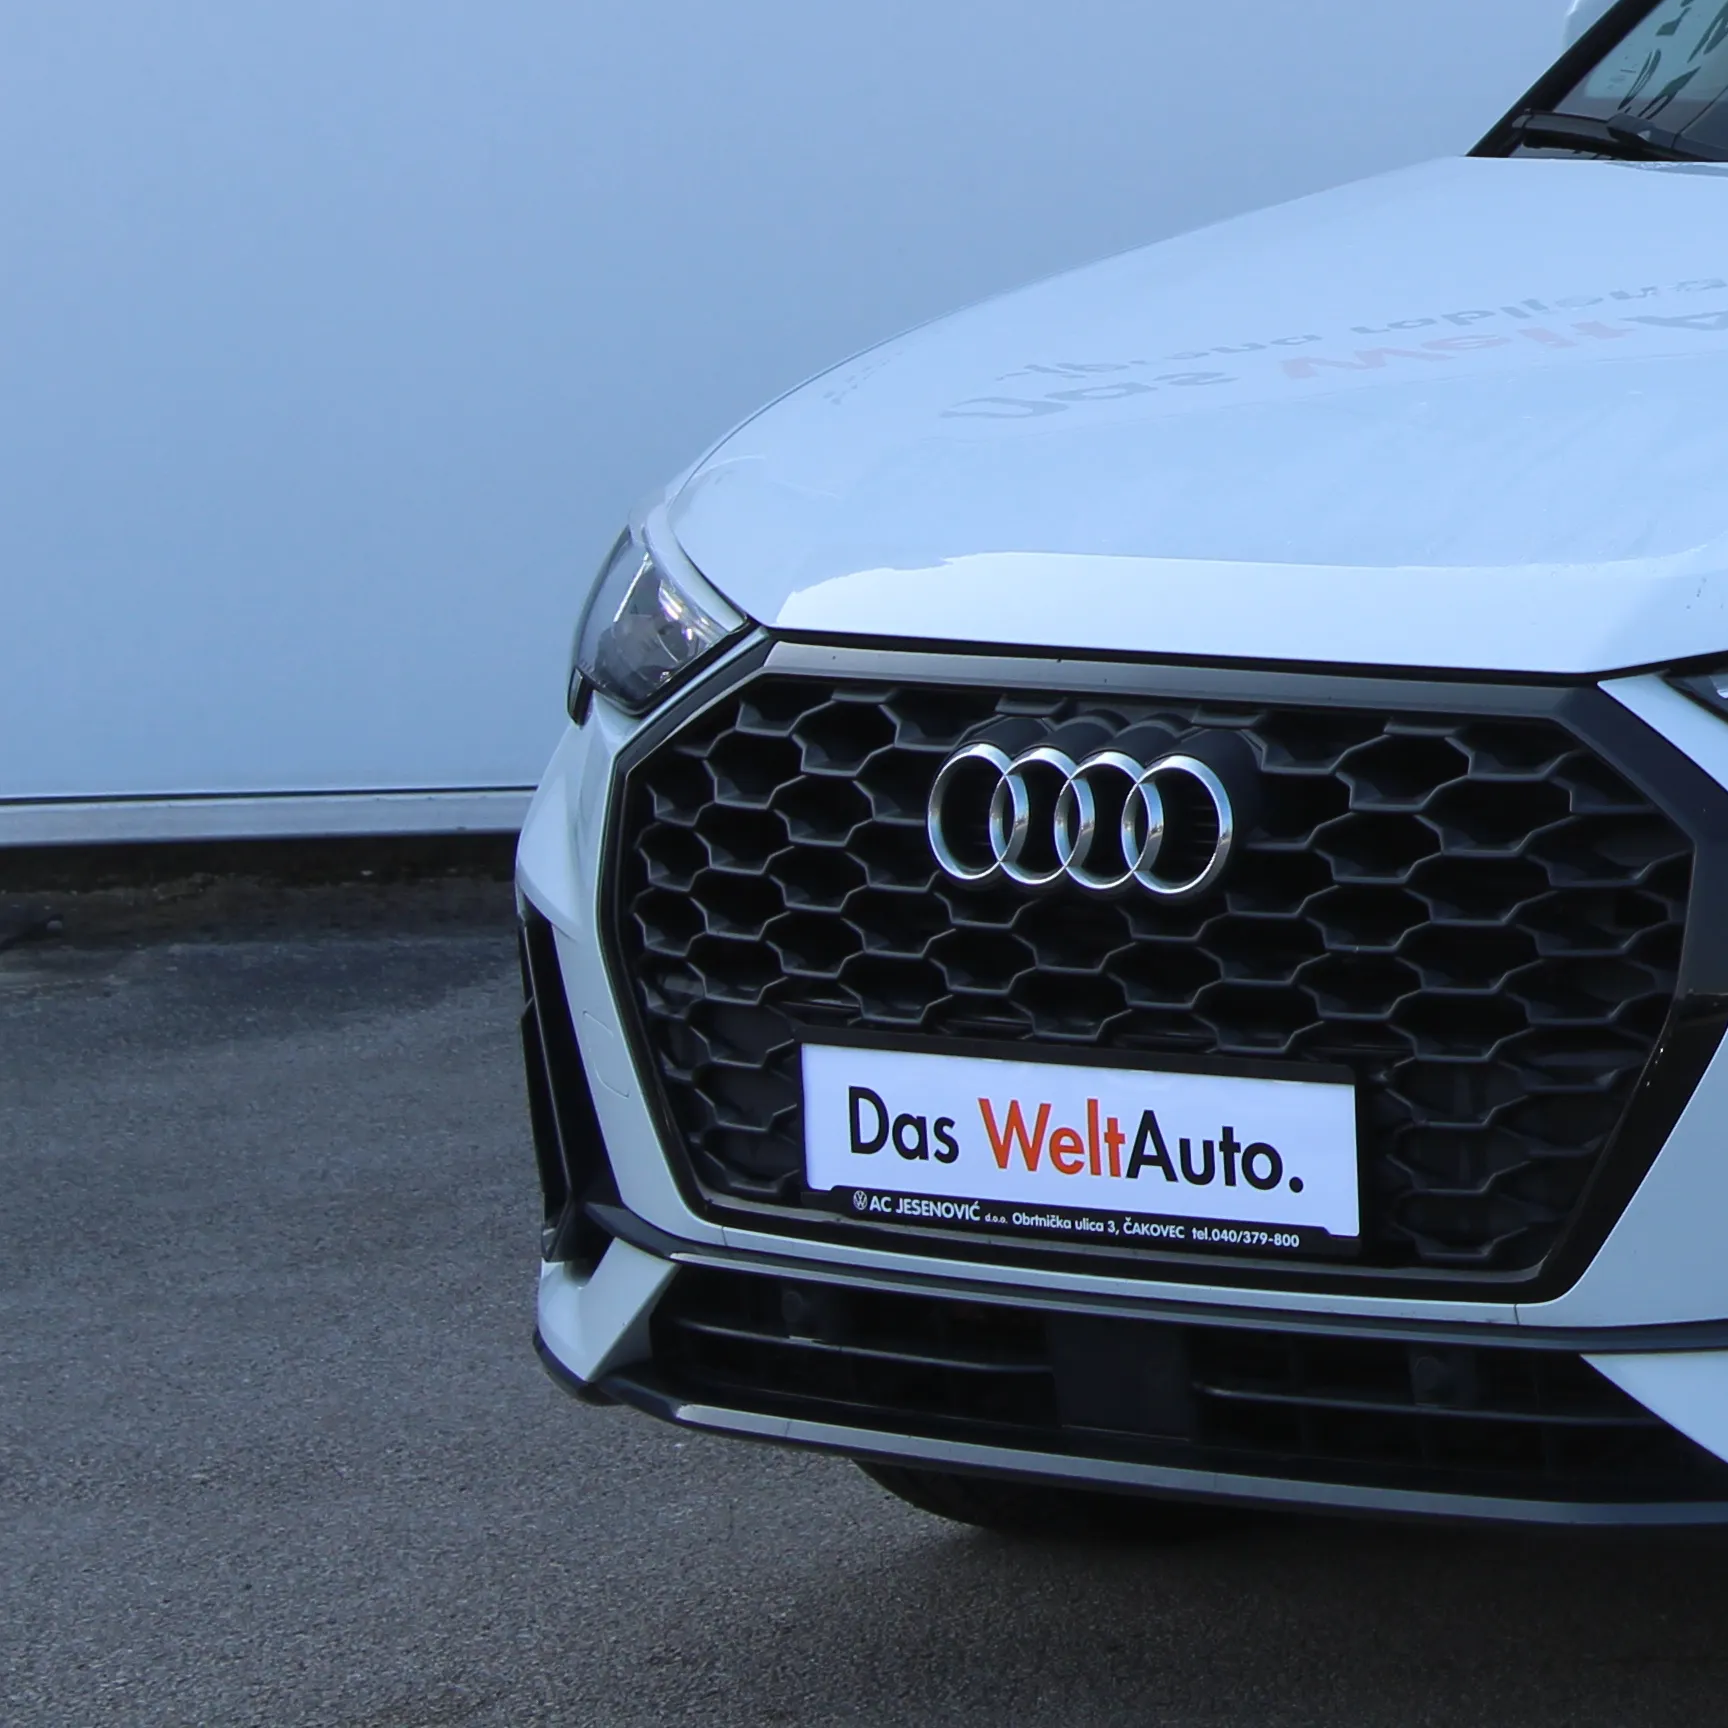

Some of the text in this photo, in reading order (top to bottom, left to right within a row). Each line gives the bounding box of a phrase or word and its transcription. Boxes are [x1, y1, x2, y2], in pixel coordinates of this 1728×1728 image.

[848, 1085, 1304, 1194] Das WeltAuto.
[869, 1195, 892, 1213] AC
[896, 1198, 981, 1221] JESENOVIĆ
[984, 1213, 1008, 1224] d.o.o.
[1012, 1212, 1072, 1230] Obrtnička
[1074, 1218, 1105, 1233] ulica
[1108, 1220, 1120, 1236] 3,
[1123, 1216, 1185, 1239] ČAKOVEC
